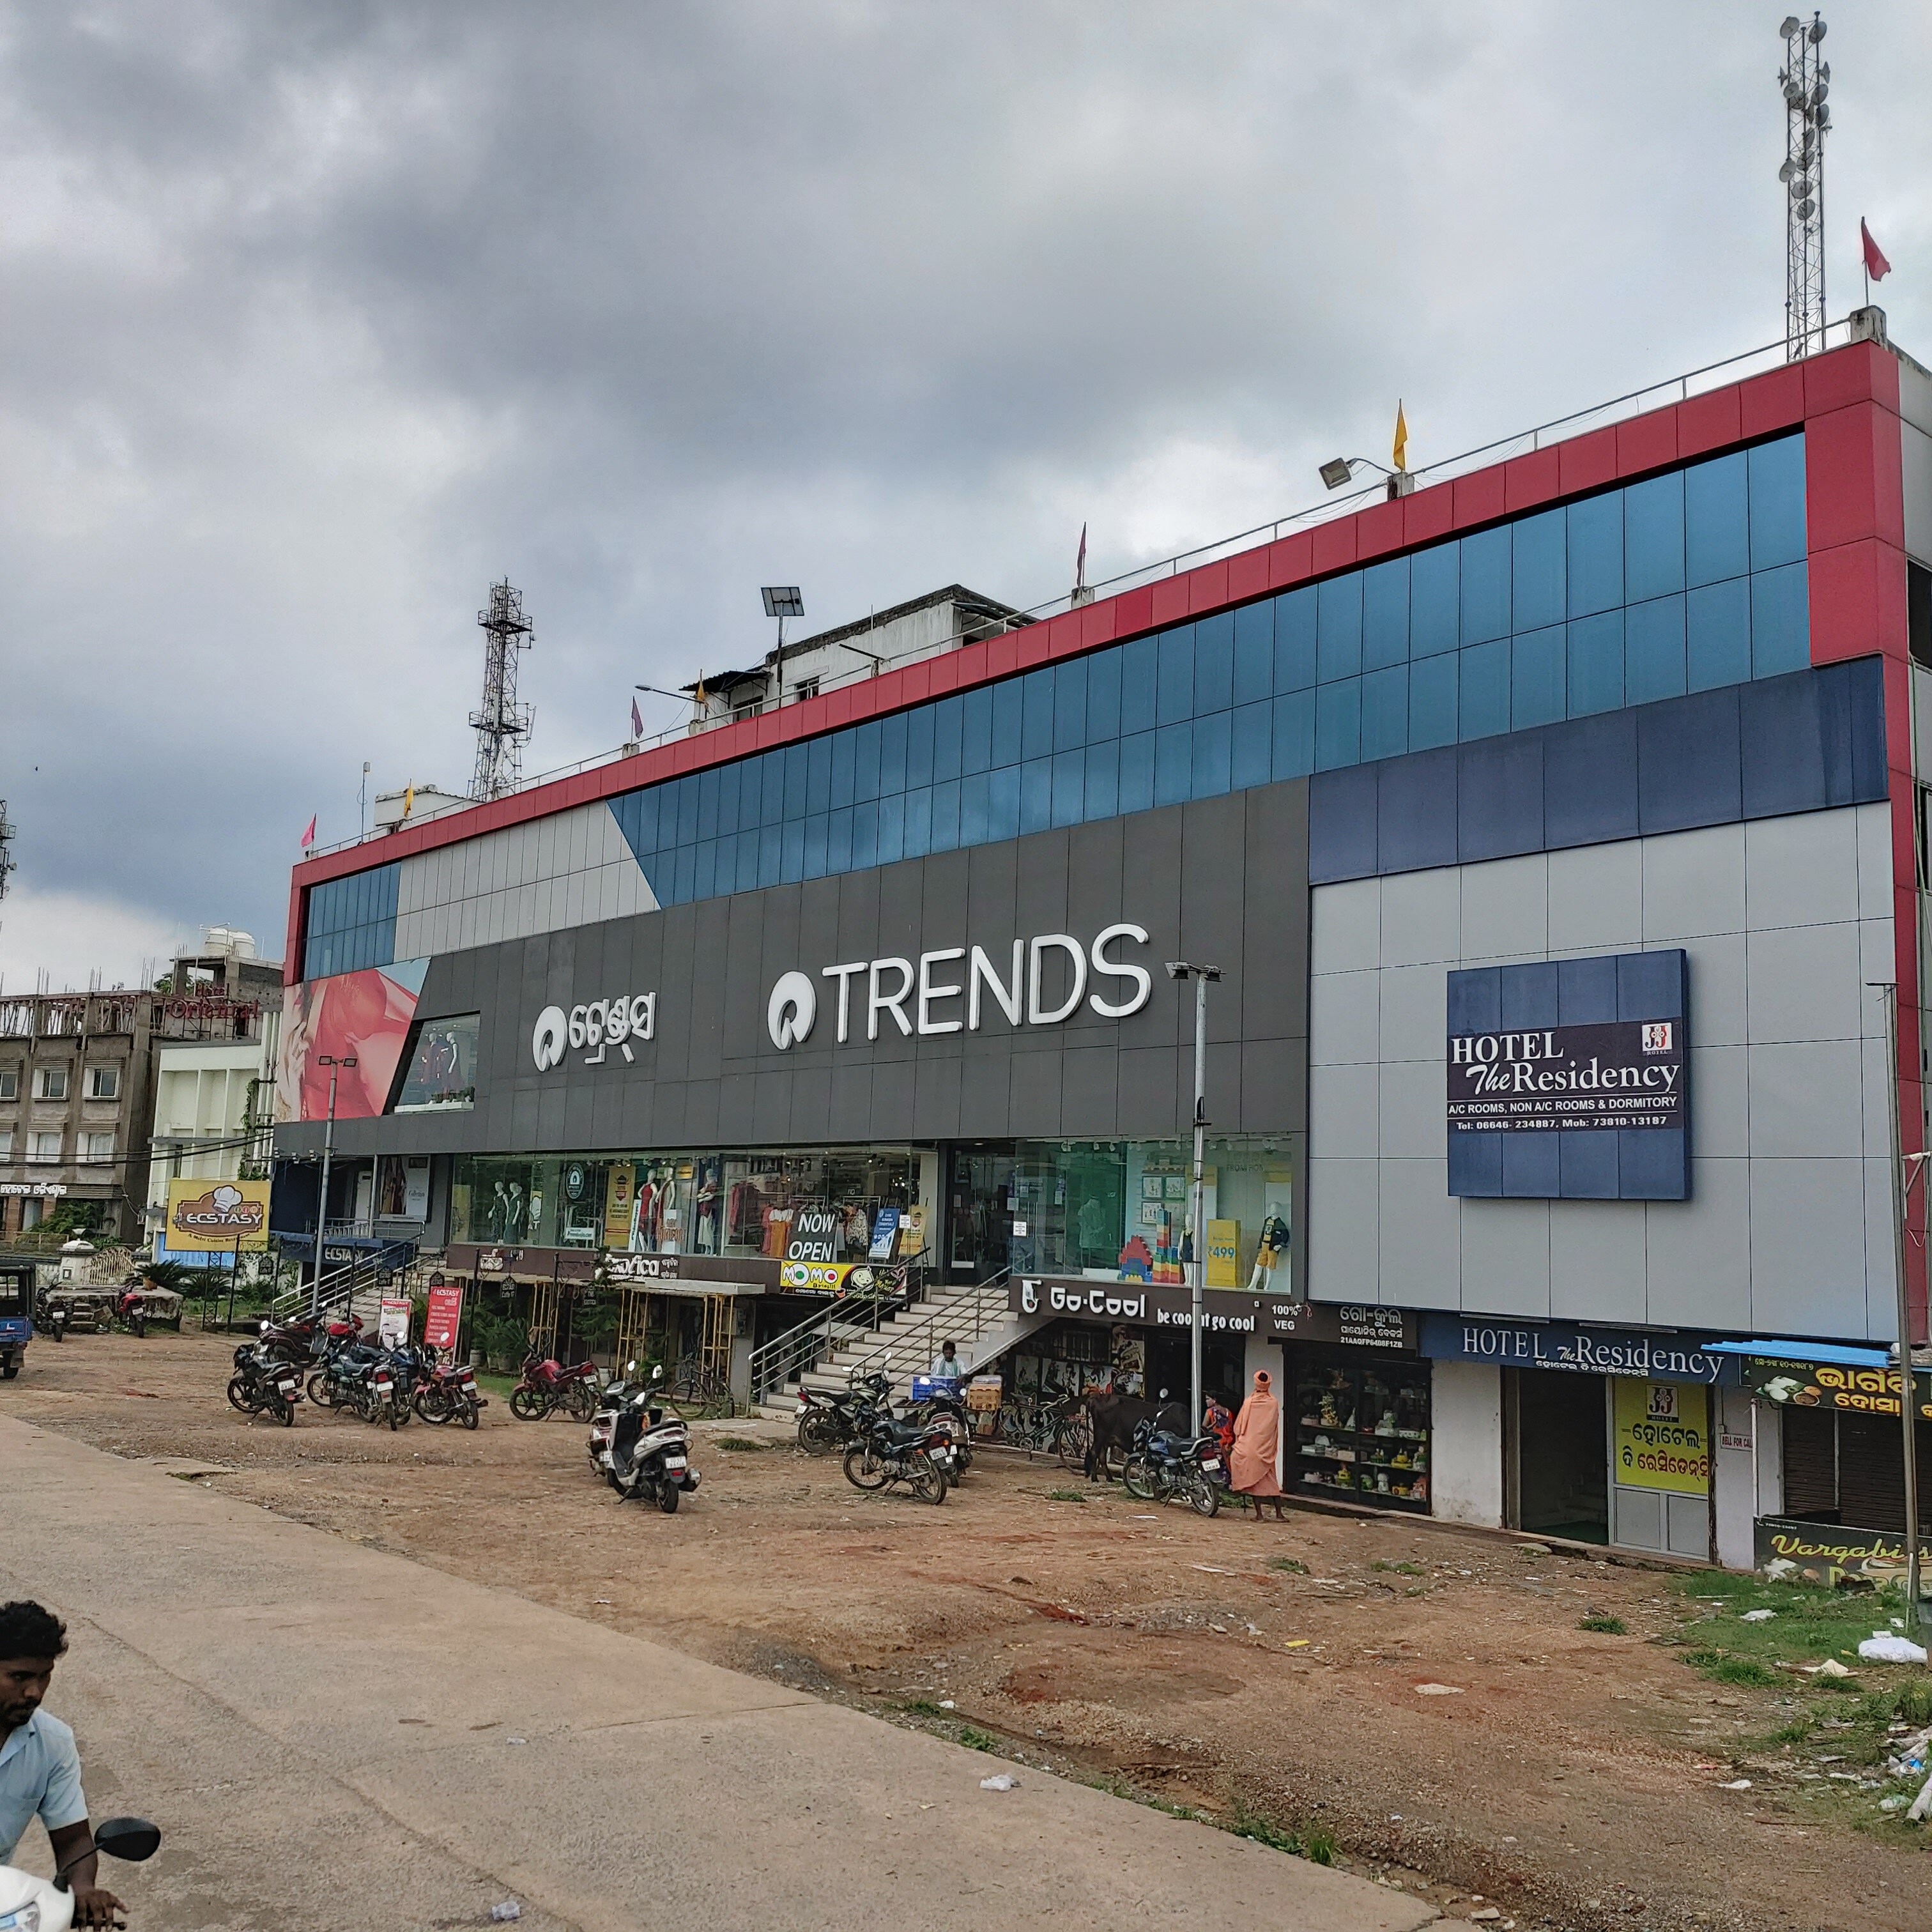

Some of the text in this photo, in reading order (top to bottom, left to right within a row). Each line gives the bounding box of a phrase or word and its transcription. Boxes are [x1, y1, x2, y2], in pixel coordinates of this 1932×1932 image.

[822, 923, 1151, 1044] TRENDS
[1451, 1032, 1564, 1064] HOTEL
[1466, 1057, 1680, 1095] The Residency
[1448, 1096, 1677, 1114] A/C ROOMS, NON A/C ROOMS & DORMITORY
[1457, 1122, 1475, 1130] Tel:
[1562, 1118, 1590, 1128] Mob:
[186, 1213, 263, 1224] ECSTASY
[798, 1213, 836, 1233] NOW
[788, 1241, 833, 1262] OPEN
[782, 1263, 838, 1286] MOMO
[1157, 1308, 1170, 1324] be
[1172, 1310, 1192, 1326] coo
[1212, 1316, 1227, 1331] go
[1229, 1315, 1255, 1331] cool
[1271, 1305, 1298, 1317] 100%
[1274, 1319, 1296, 1331] VEG
[1462, 1328, 1725, 1384] HOTEL The Residency
[1632, 1422, 1701, 1450] ହୋଟେଲ
[1722, 1435, 1732, 1446] BELL
[1733, 1437, 1742, 1447] FOR
[1623, 1445, 1633, 1468] ଦି
